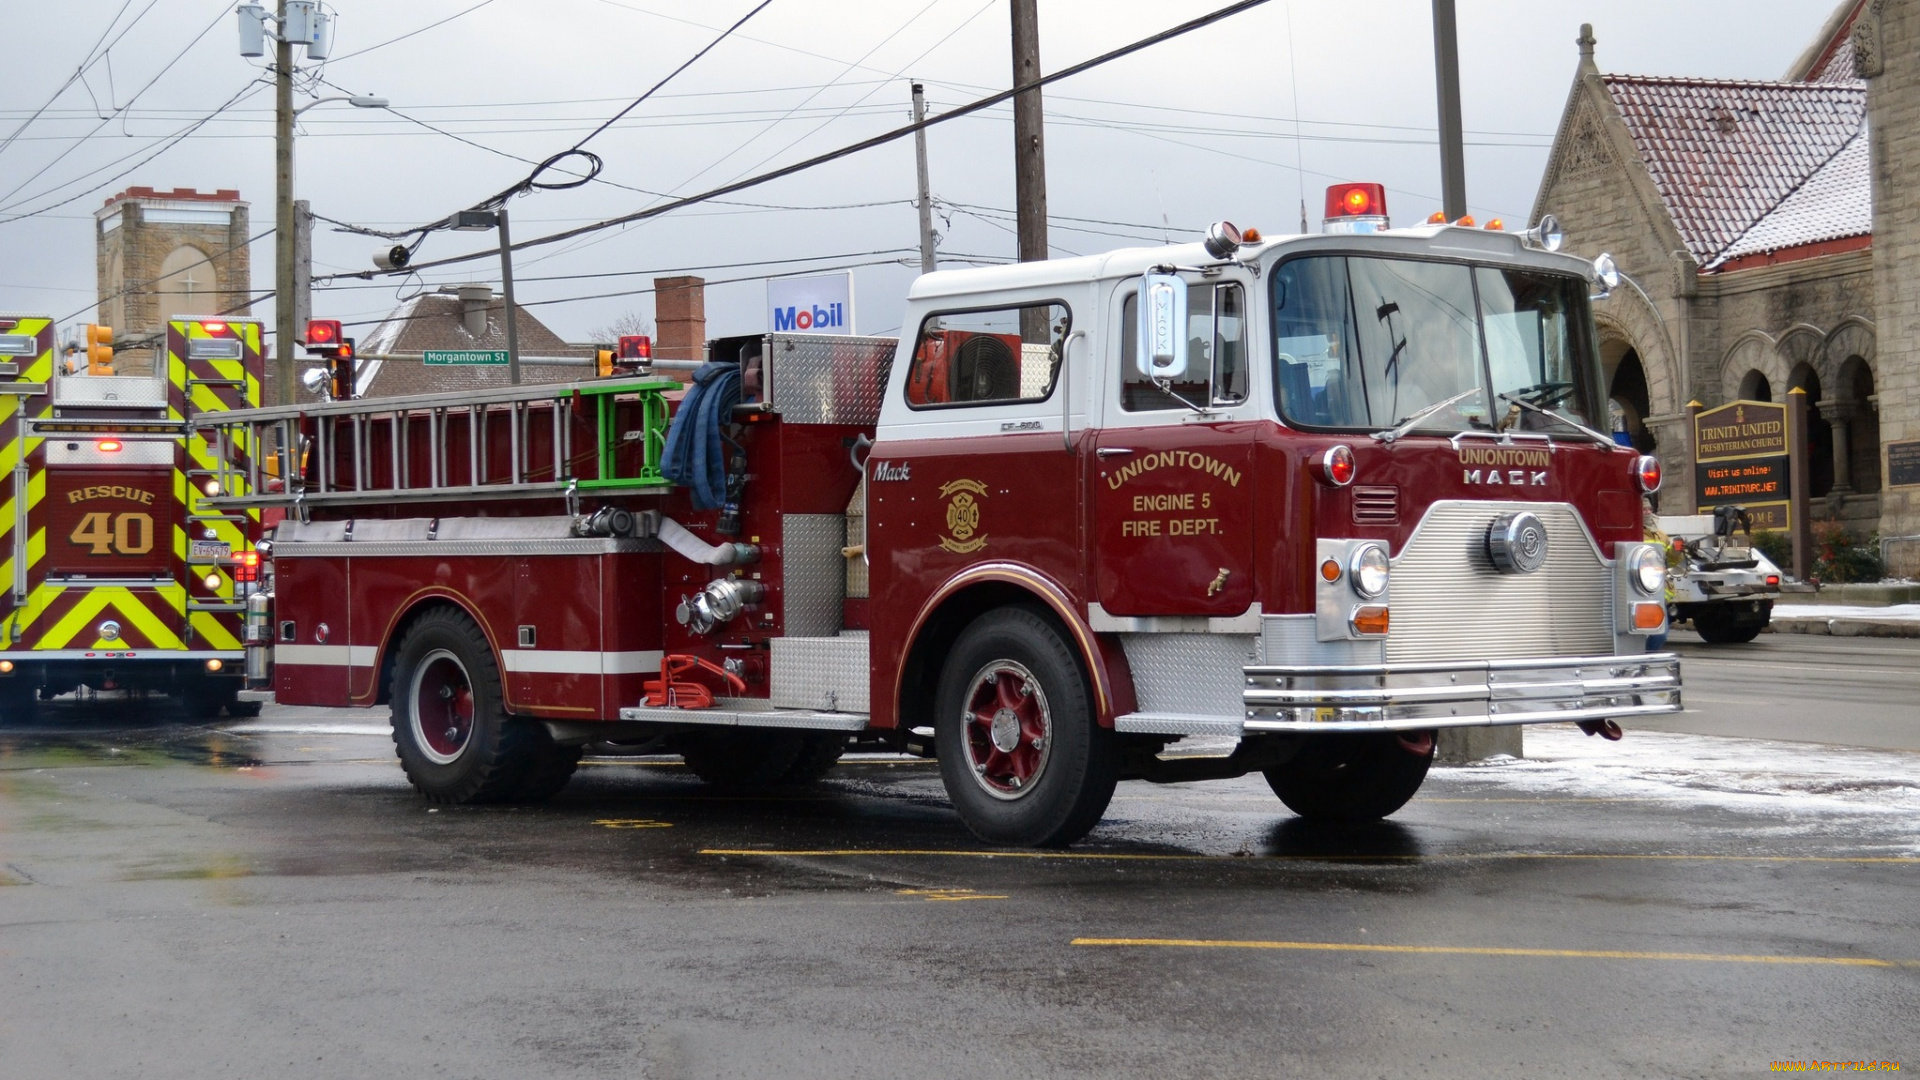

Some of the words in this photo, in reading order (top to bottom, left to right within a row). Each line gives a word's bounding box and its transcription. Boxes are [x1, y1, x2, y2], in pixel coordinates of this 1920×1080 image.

[774, 302, 843, 332] Mobil
[428, 352, 492, 364] Morgantown
[494, 353, 505, 362] St
[1701, 425, 1740, 441] TRINITY
[1742, 421, 1781, 436] UNITED
[1700, 440, 1750, 453] PRESBYTERIAN
[1751, 436, 1783, 449] CHURCH
[1459, 448, 1549, 467] UNIONTOWN
[872, 460, 912, 482] Mack
[1107, 450, 1242, 490] UNIONTOWN
[1463, 469, 1547, 486] MACK
[1707, 469, 1729, 479] Visit
[1731, 468, 1741, 477] us
[67, 485, 155, 506] RESCUE
[1133, 494, 1195, 512] ENGINE
[1201, 493, 1211, 509] 5
[957, 509, 968, 523] 40
[69, 512, 154, 556] 40
[1122, 520, 1161, 537] FIRE
[1169, 518, 1224, 536] DEPT.
